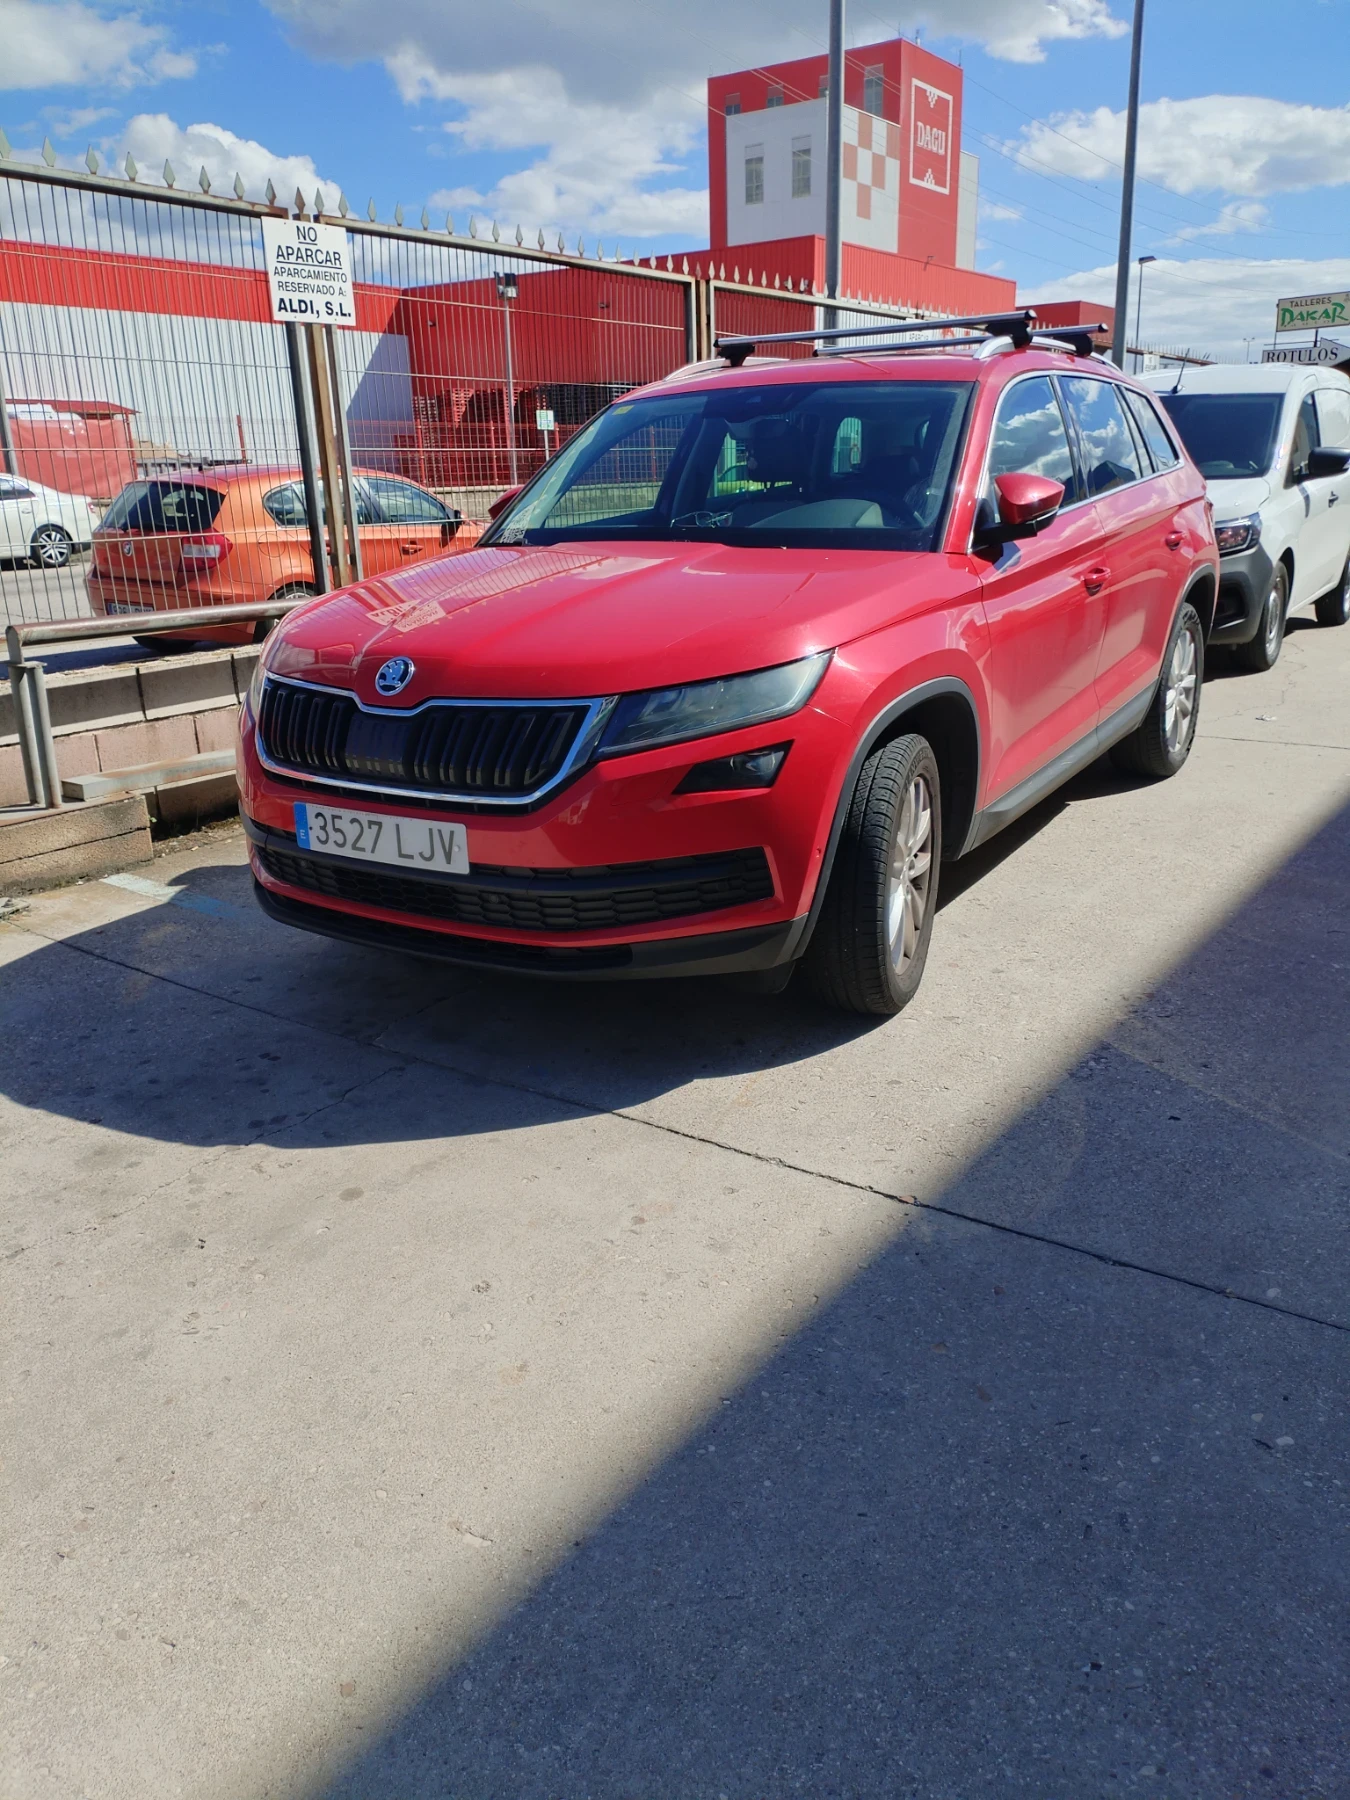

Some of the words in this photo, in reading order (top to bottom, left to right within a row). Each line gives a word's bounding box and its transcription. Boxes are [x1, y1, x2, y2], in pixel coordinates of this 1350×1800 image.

[917, 121, 946, 155] DAGU
[296, 225, 318, 242] NO
[276, 244, 342, 267] APARCAR
[273, 266, 347, 283] APARCAMIENTO
[277, 281, 335, 296] RESERVADO
[277, 297, 320, 318] ALDI,
[325, 301, 351, 317] S.L.
[1290, 297, 1332, 308] TALLERES
[1280, 302, 1349, 327] DAKAR
[1266, 347, 1339, 363] ROTULOS
[314, 811, 383, 854] 3527
[395, 823, 455, 865] LJV
